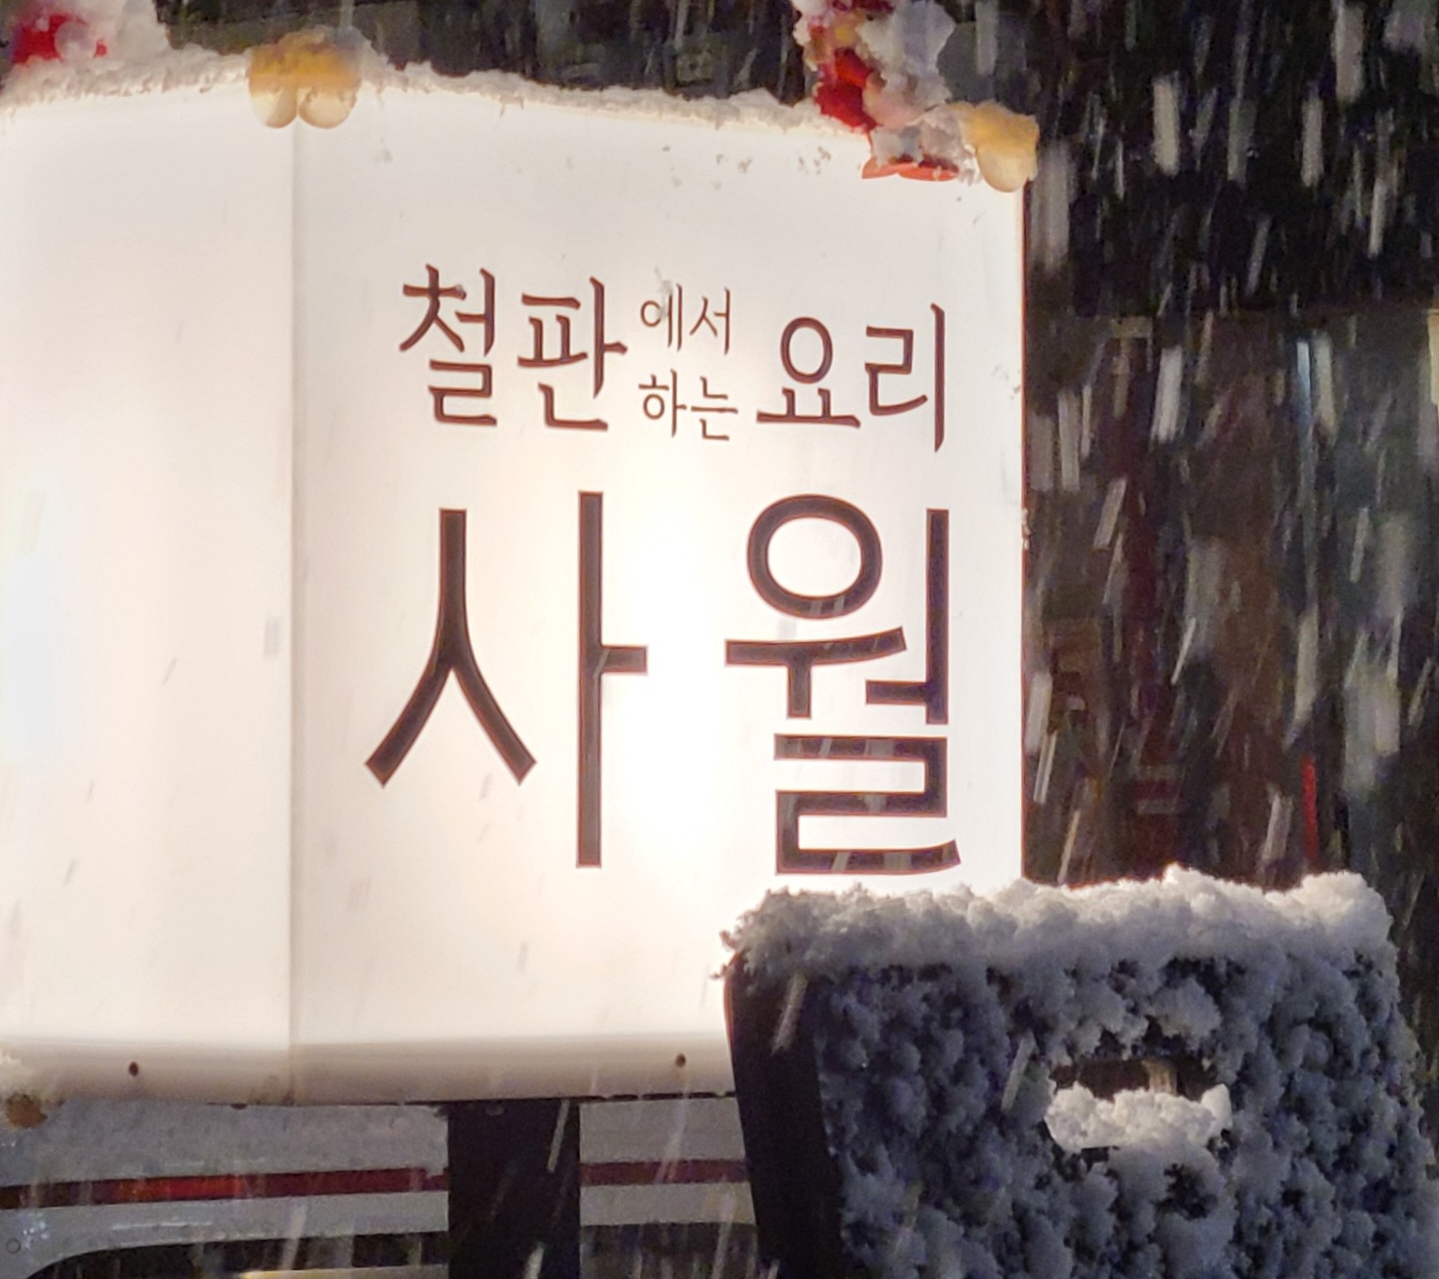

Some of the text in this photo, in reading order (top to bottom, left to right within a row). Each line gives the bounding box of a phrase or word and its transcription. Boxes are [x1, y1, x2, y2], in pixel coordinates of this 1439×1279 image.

[399, 263, 629, 433] 철판
[639, 283, 731, 356] 에서
[755, 302, 946, 453] 요리
[637, 368, 739, 441] 하는
[364, 490, 962, 876] 사월
